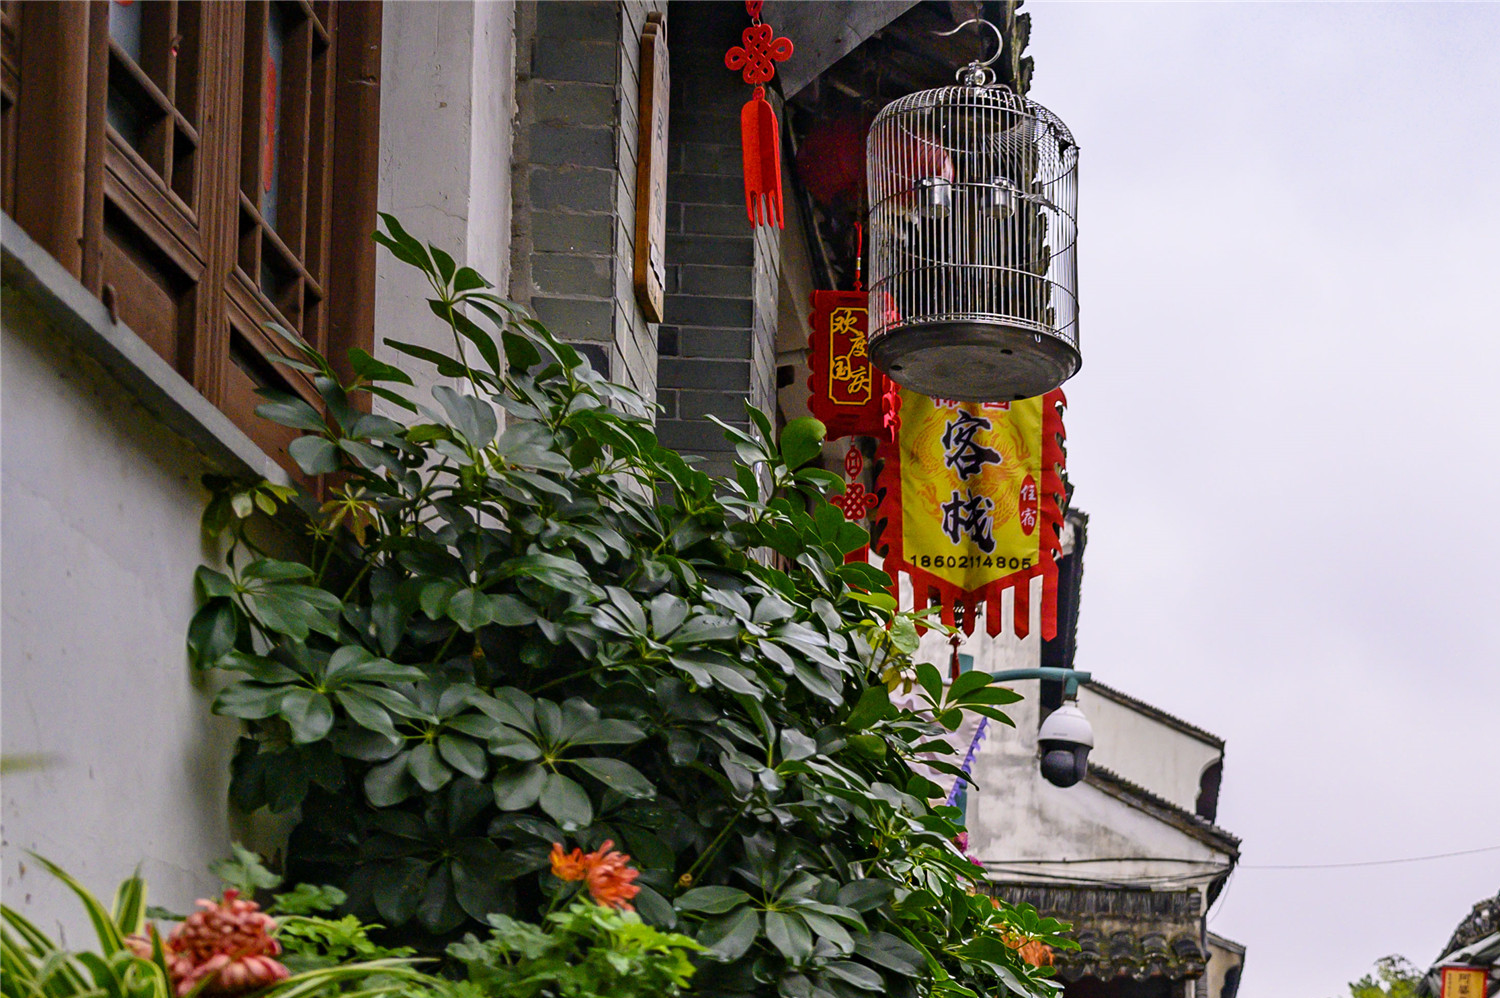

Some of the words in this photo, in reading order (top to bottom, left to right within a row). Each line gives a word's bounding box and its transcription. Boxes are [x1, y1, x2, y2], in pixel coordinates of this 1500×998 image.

[833, 309, 870, 394] 欢度国庆
[941, 408, 1002, 554] 客栈
[1020, 484, 1037, 527] 住宿
[911, 555, 1032, 570] 18602114805
